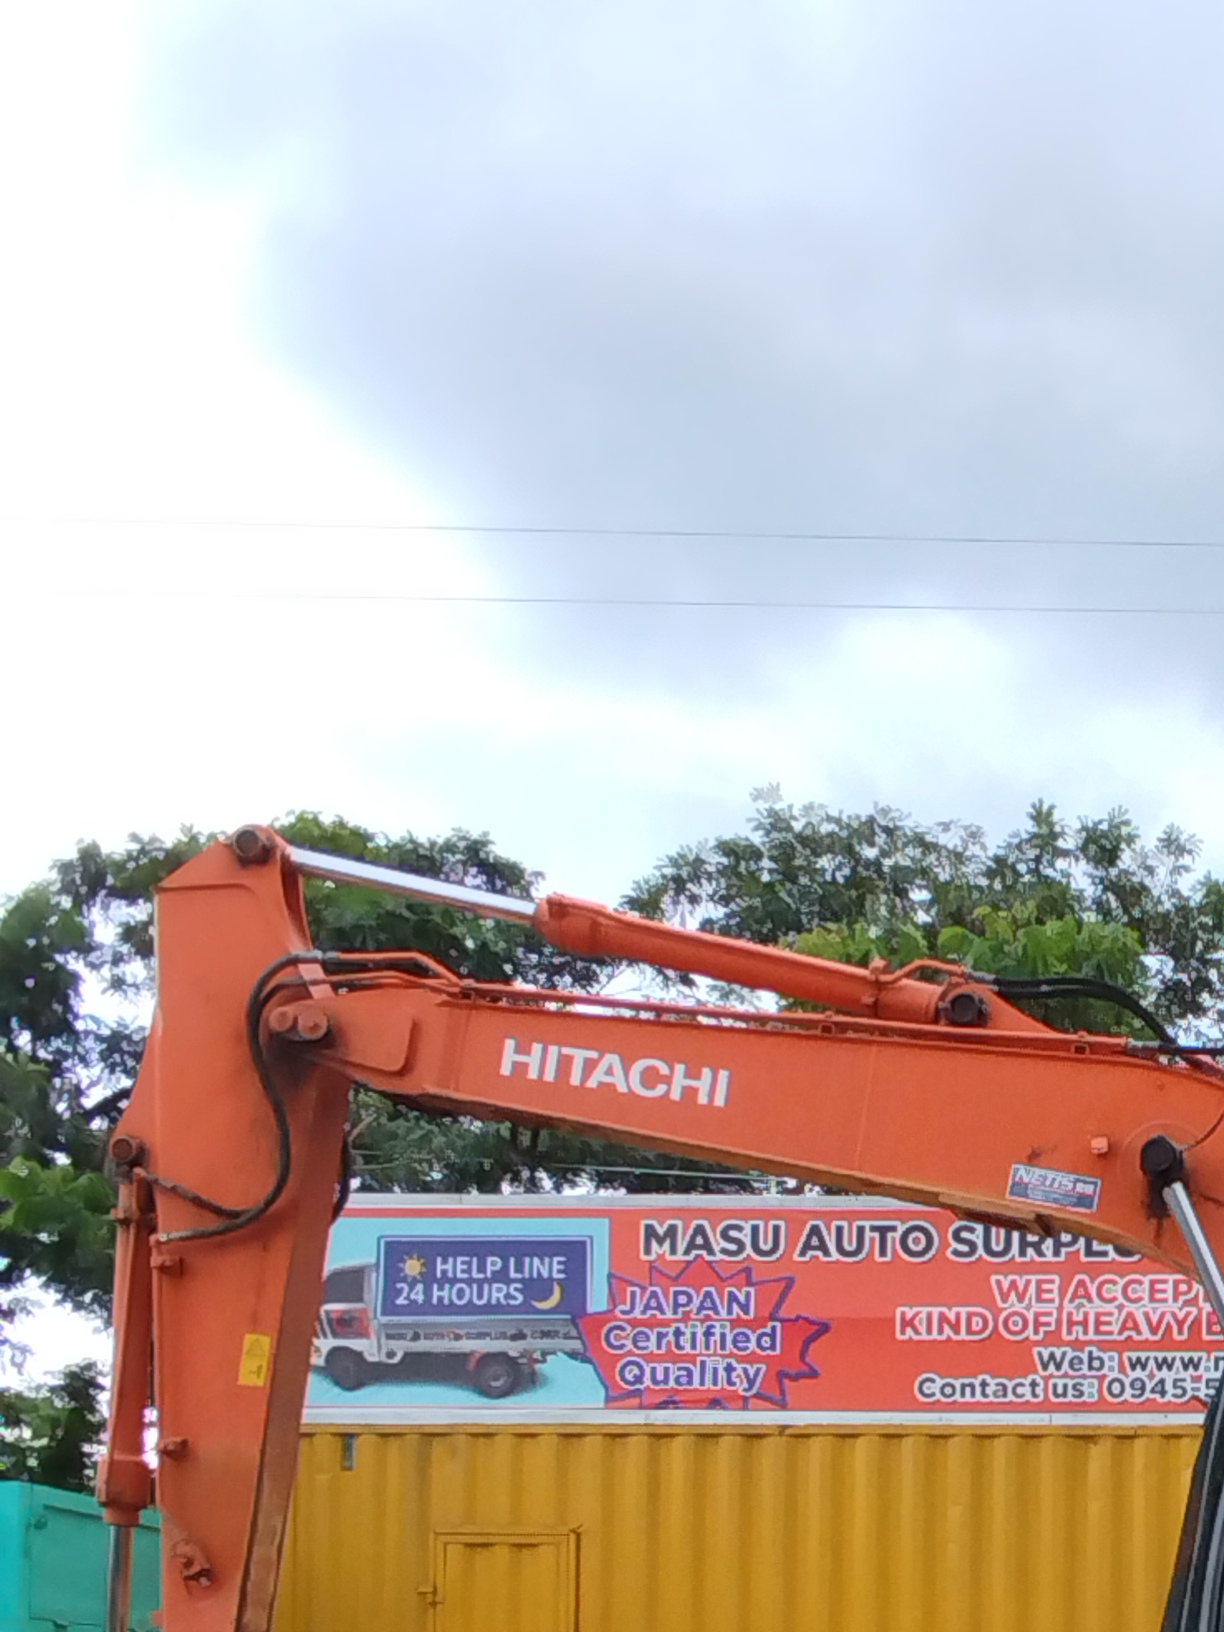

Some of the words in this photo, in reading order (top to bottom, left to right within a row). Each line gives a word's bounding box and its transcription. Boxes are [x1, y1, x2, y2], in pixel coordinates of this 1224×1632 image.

[500, 1038, 730, 1108] HITACHI
[641, 1222, 785, 1260] MASU
[797, 1222, 938, 1260] AUTO
[435, 1256, 503, 1279] HELP
[508, 1256, 567, 1279] LINE
[394, 1283, 425, 1305] 24
[430, 1283, 524, 1305] HOURS
[616, 1287, 753, 1318] JAPAN
[993, 1275, 1059, 1305] WE
[604, 1322, 780, 1352] Certified
[897, 1308, 991, 1339] KIND
[1000, 1308, 1057, 1339] OF
[1063, 1308, 1198, 1339] HEAVY
[1035, 1347, 1117, 1373] Web:
[618, 1359, 766, 1393] Quality
[916, 1374, 1043, 1401] Contact
[1049, 1379, 1097, 1400] us:
